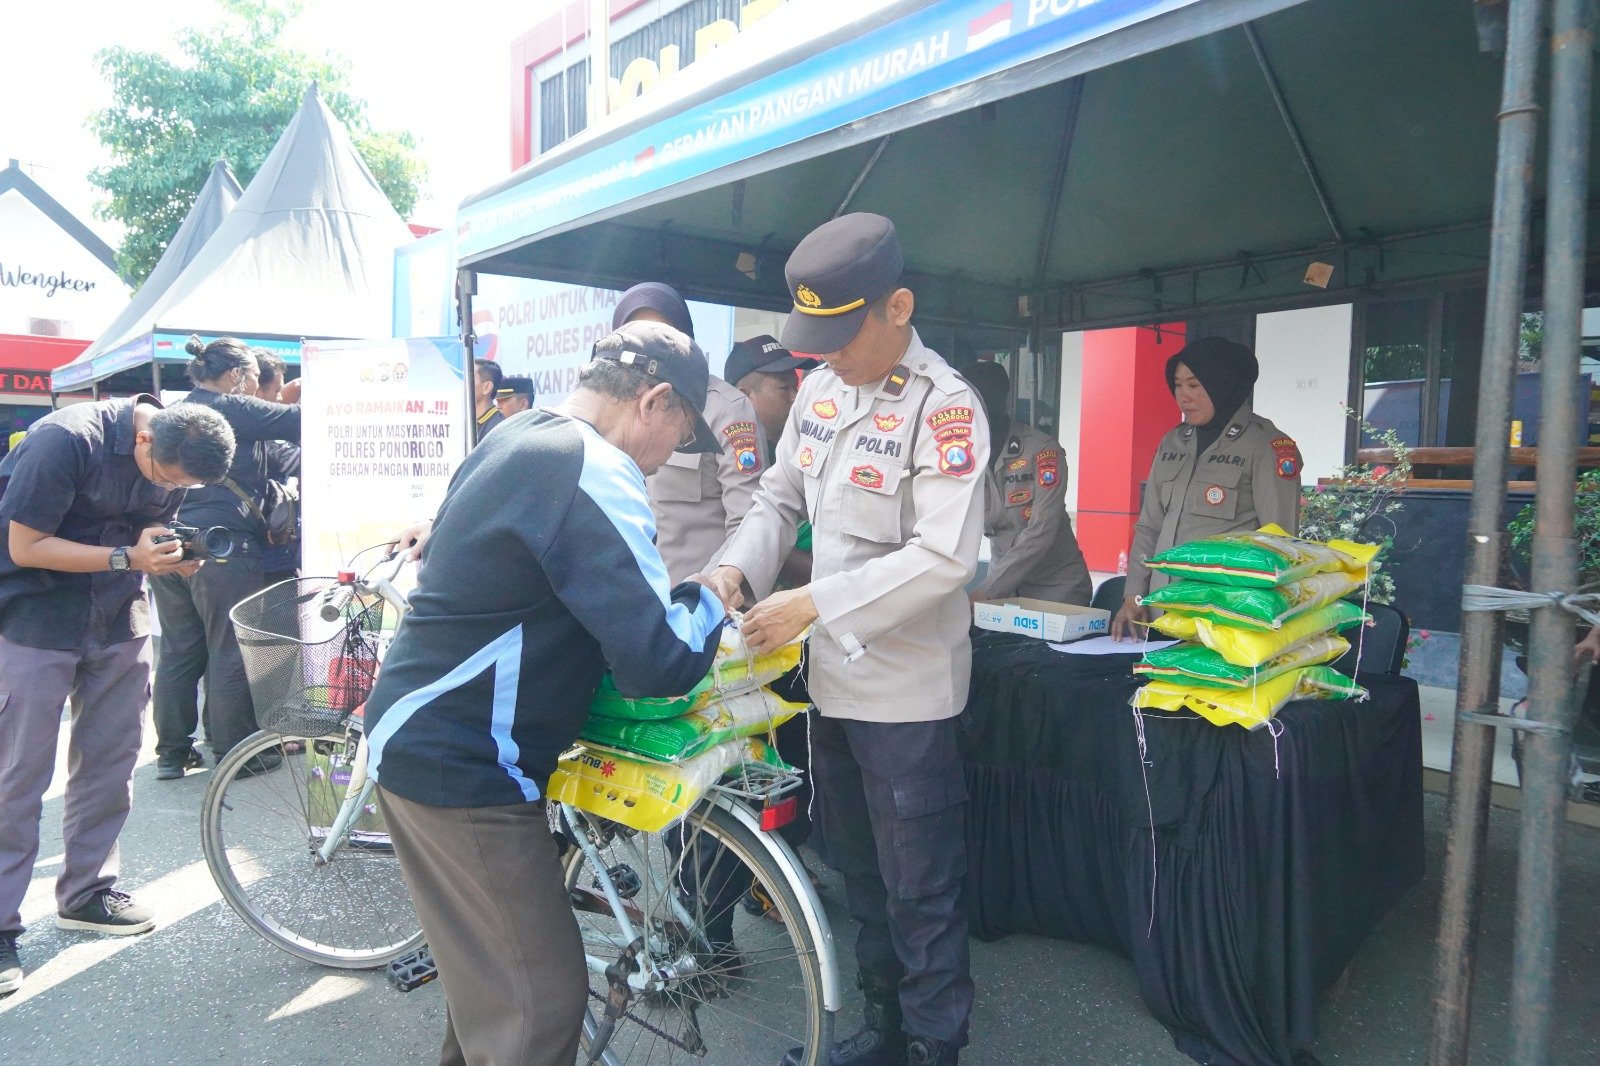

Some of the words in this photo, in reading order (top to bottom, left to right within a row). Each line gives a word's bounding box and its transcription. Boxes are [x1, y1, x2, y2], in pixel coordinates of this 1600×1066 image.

[750, 72, 844, 129] PANGAN
[848, 30, 950, 93] MURAH
[0, 262, 96, 298] Wengker
[498, 299, 535, 329] POLRI
[540, 286, 588, 321] UNTUK
[527, 326, 579, 359] POLRES
[326, 404, 352, 416] AYO
[356, 400, 424, 414] RAMAIKAN
[931, 409, 969, 420] POLRES
[328, 425, 352, 439] POLRI
[356, 425, 382, 439] UNTUK
[386, 424, 450, 438] MASYARAKAT
[335, 441, 375, 459] POLRES
[379, 441, 443, 459] PONOROGO
[855, 435, 902, 457] POLRI
[330, 463, 369, 476] GERAKAN
[372, 463, 408, 476] PANGAN
[413, 463, 449, 476] MURAH
[1208, 454, 1246, 467] POLRI
